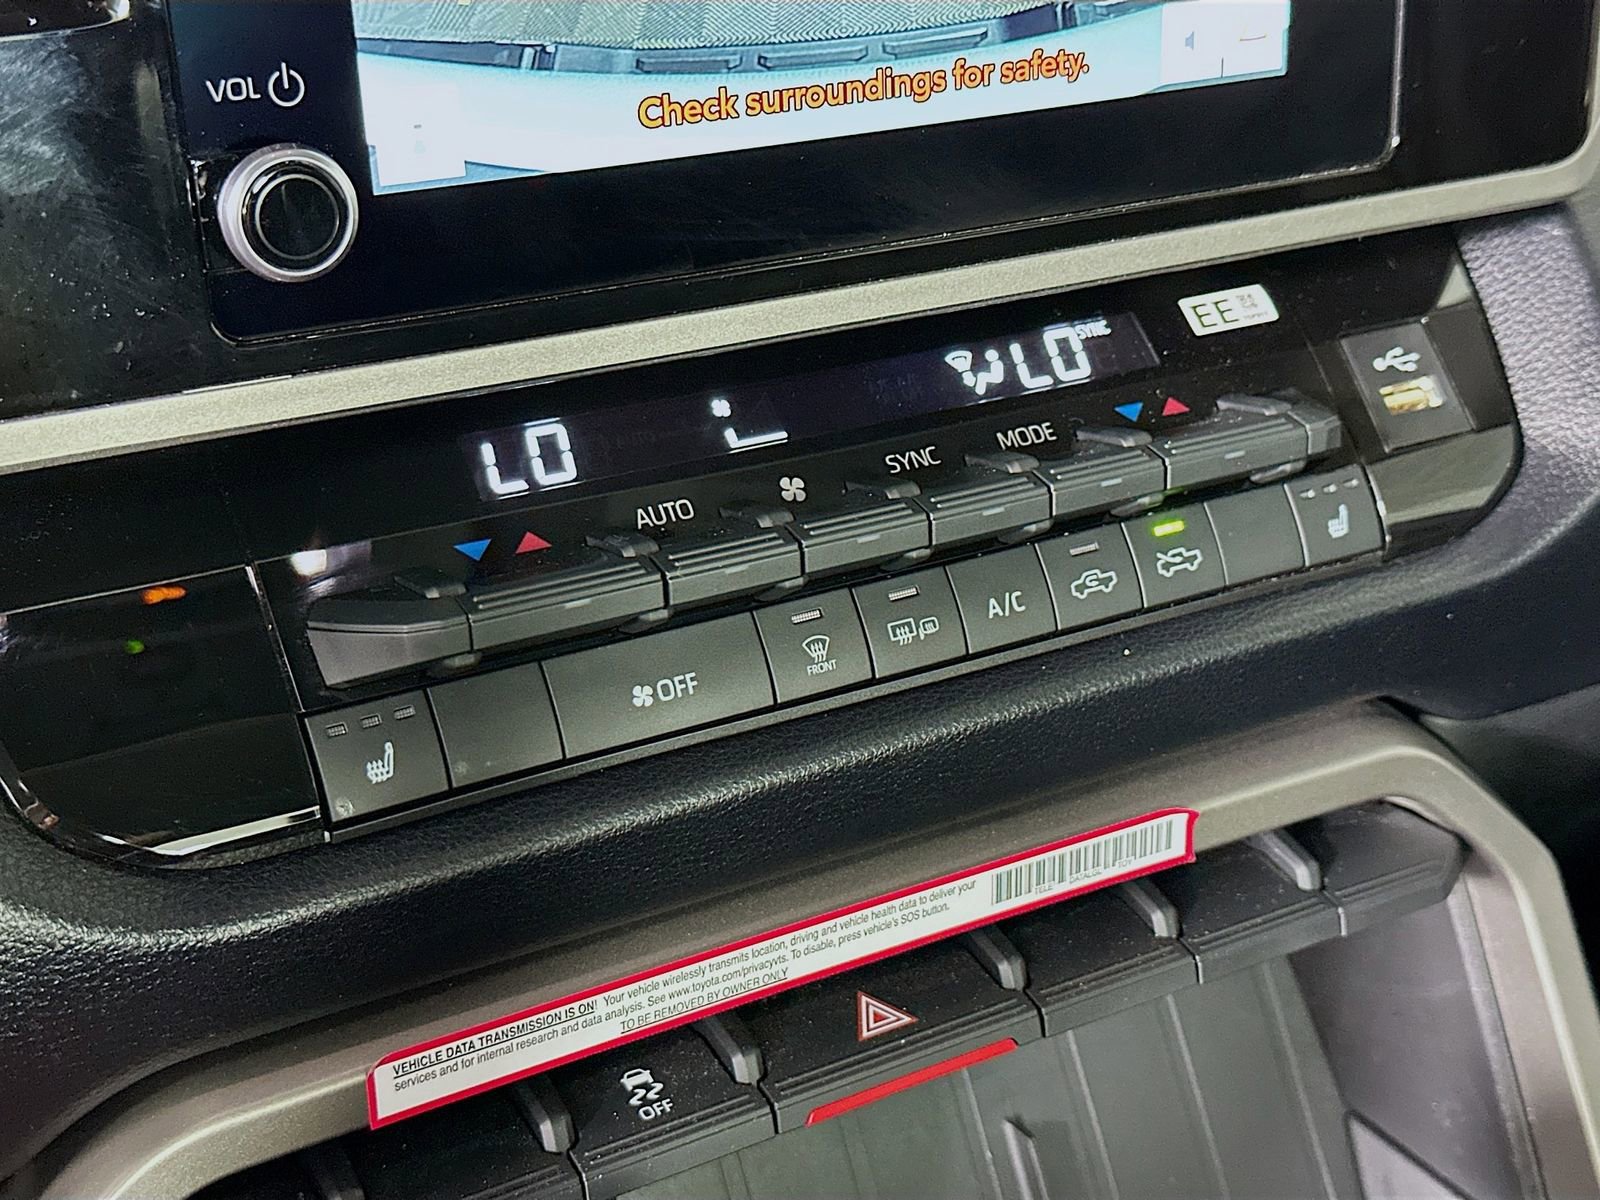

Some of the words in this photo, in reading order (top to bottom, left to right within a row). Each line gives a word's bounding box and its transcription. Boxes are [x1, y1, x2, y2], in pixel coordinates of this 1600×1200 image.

[205, 77, 262, 103] VOL
[637, 87, 739, 130] Check
[745, 66, 947, 119] surroundings
[952, 57, 996, 91] for
[1000, 48, 1090, 84] safety.
[1190, 299, 1240, 329] EE
[1076, 319, 1112, 340] SYNC
[996, 422, 1058, 450] MODE
[885, 445, 941, 474] SYNC
[636, 498, 695, 530] AUTO
[988, 591, 1027, 619] A/C
[807, 659, 837, 676] FRONT
[657, 672, 698, 702] OFF
[393, 1049, 443, 1077] VEHICLE
[446, 1041, 476, 1059] DATA
[478, 1010, 562, 1047] TRANSMISSION
[565, 1006, 575, 1020] IS
[578, 999, 597, 1016] ON!
[603, 992, 625, 1007] Your
[627, 981, 660, 998] vehicle
[662, 965, 706, 988] wirelessly
[709, 951, 749, 972] transmits
[752, 940, 788, 960] location,
[790, 930, 819, 948] driving
[822, 922, 838, 936] and
[840, 914, 869, 931] vehicle
[871, 904, 897, 920] health
[899, 899, 917, 912] data
[919, 895, 928, 905] to
[929, 886, 957, 902] deliver
[958, 880, 976, 896] your
[394, 1071, 437, 1092] services
[439, 1060, 459, 1077] and
[461, 1055, 475, 1070] for
[477, 1042, 514, 1065] internal
[516, 1028, 559, 1051] research
[561, 1020, 580, 1036] and
[581, 1015, 603, 1029] data
[605, 1003, 646, 1023] analysis.
[647, 993, 666, 1008] See
[668, 954, 789, 1000] www.toyota.com/privacyvts.
[791, 948, 802, 960] To
[803, 941, 836, 957] disable,
[838, 930, 861, 947] press
[863, 917, 899, 937] vehicle's
[901, 910, 920, 925] SOS
[922, 902, 950, 918] button.
[620, 1020, 636, 1033] TO
[638, 1012, 652, 1026] BE
[654, 996, 705, 1019] REMOVED
[707, 990, 721, 1003] BY
[722, 975, 760, 997] OWNER
[762, 967, 788, 984] ONLY
[638, 1098, 674, 1121] OFF
